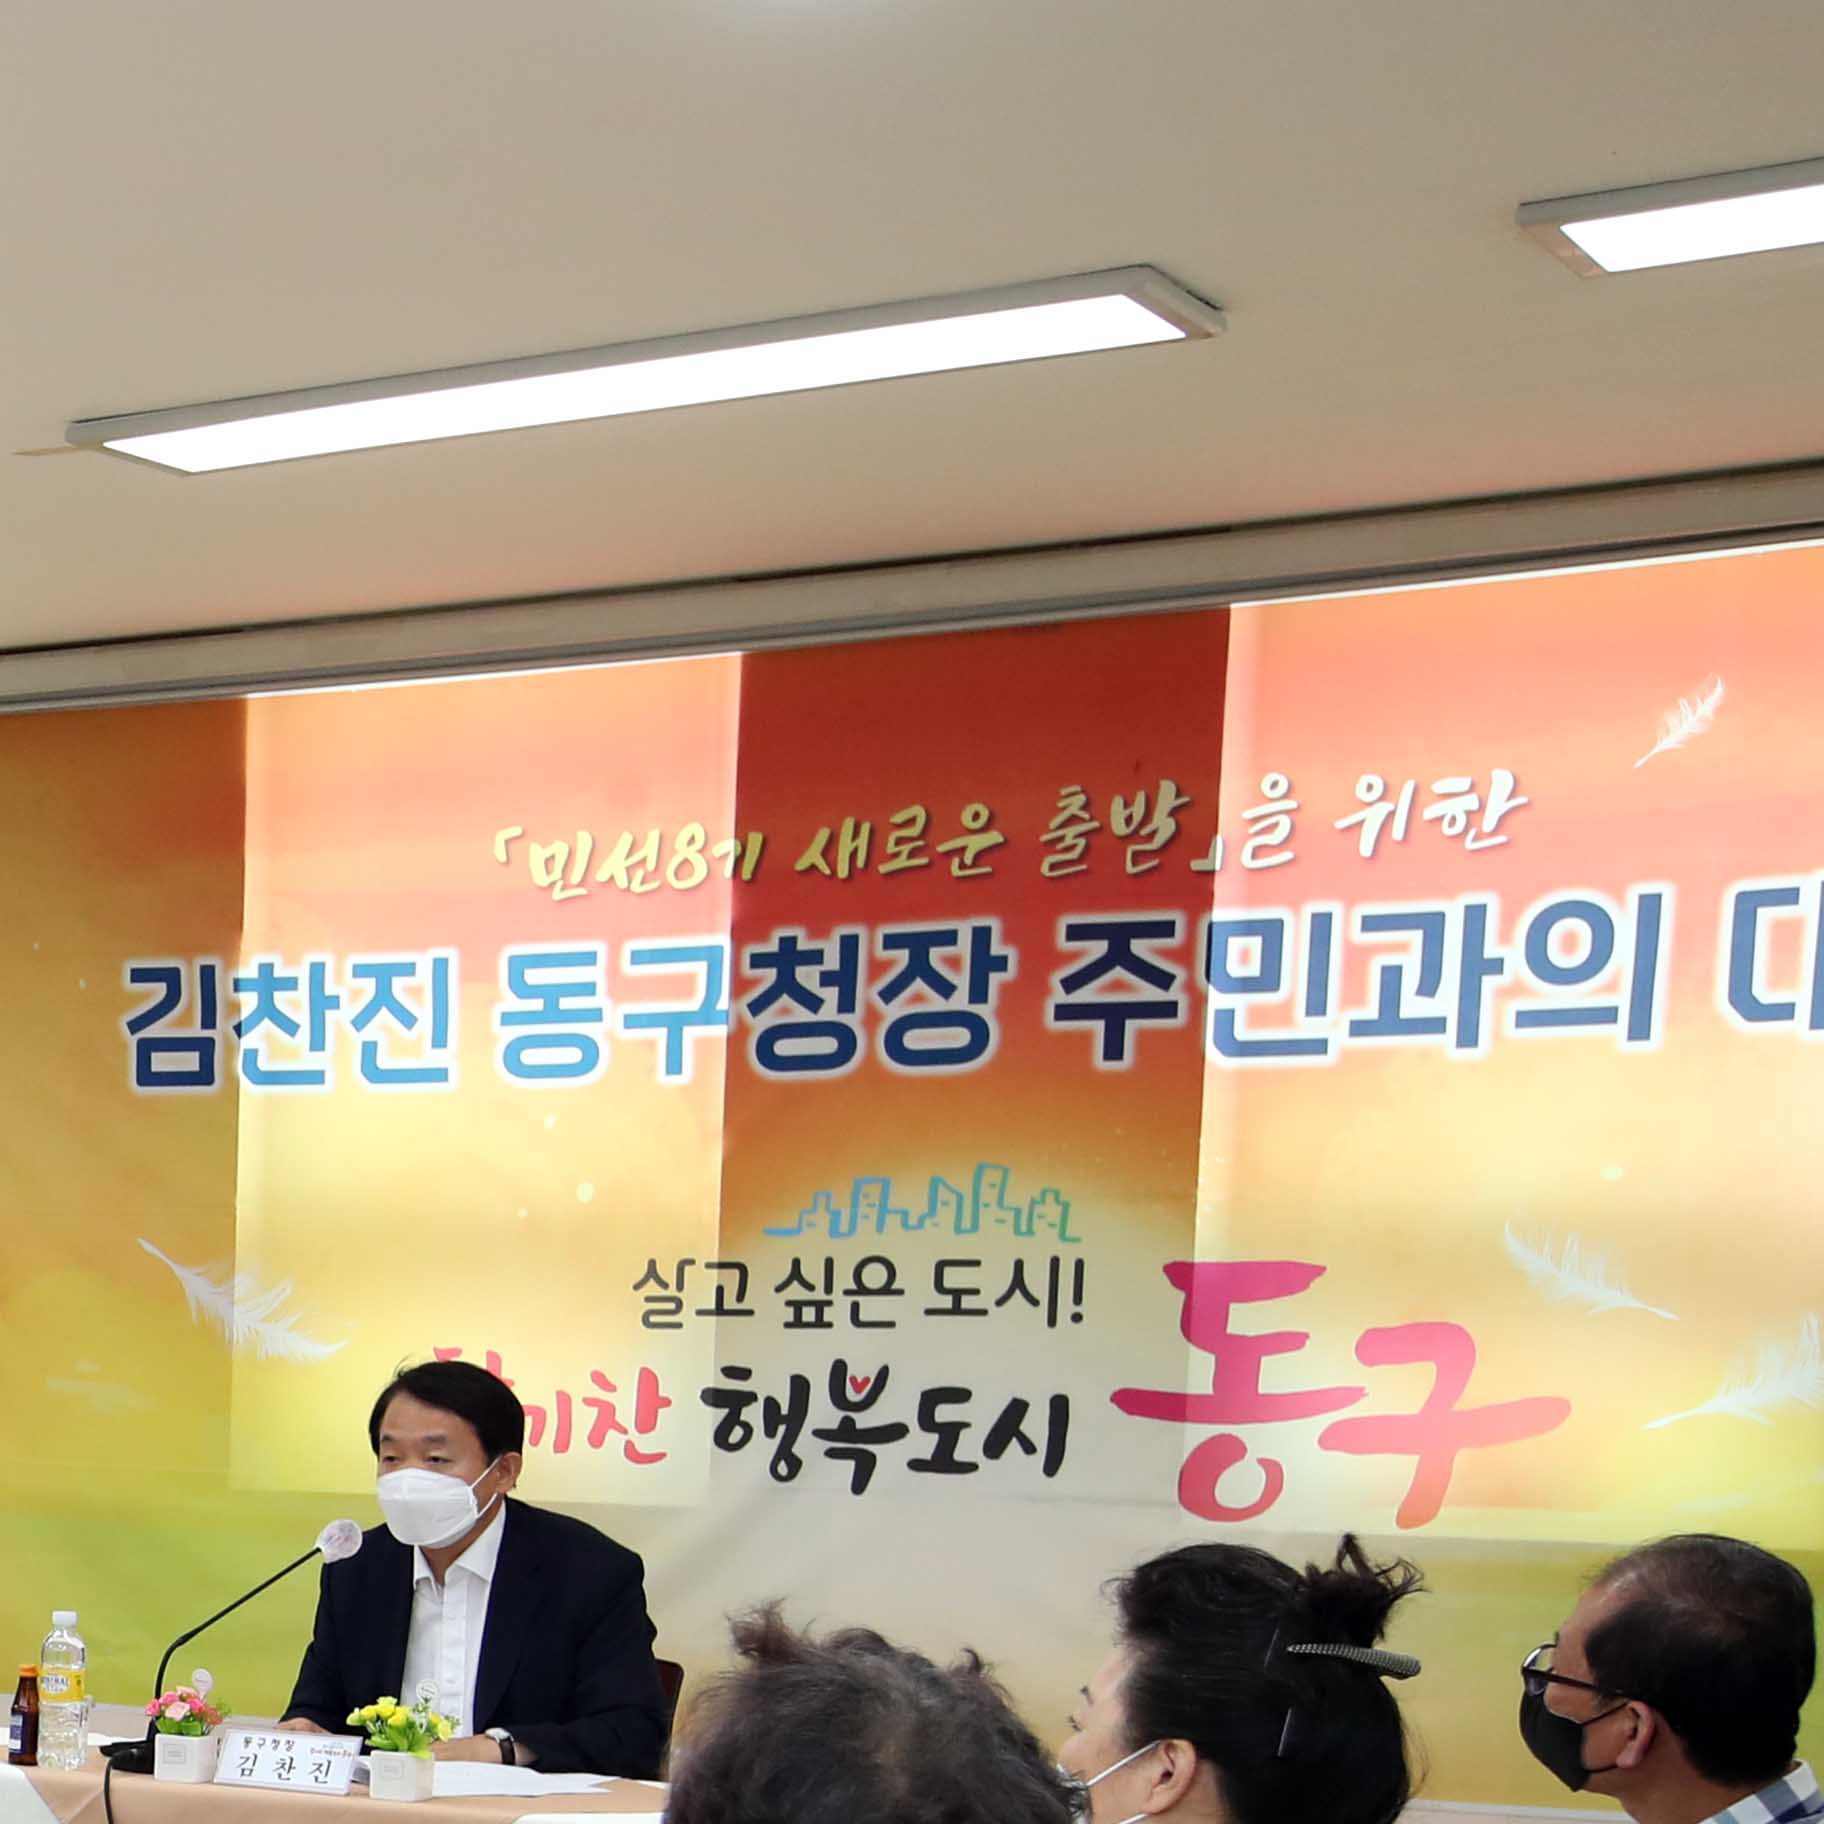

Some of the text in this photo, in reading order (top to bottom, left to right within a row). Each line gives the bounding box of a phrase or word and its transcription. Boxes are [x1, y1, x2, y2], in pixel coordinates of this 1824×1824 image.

[794, 803, 1006, 882] 새로운
[1334, 768, 1528, 858] 위한
[123, 955, 452, 1089] 김찬진
[498, 920, 1010, 1081] 동구청장
[1052, 892, 1665, 1063] 주민과의
[632, 1254, 1086, 1330] 살고 싶은 도시!
[699, 1357, 1070, 1496] 행복도시
[1109, 1259, 1573, 1530] 동구
